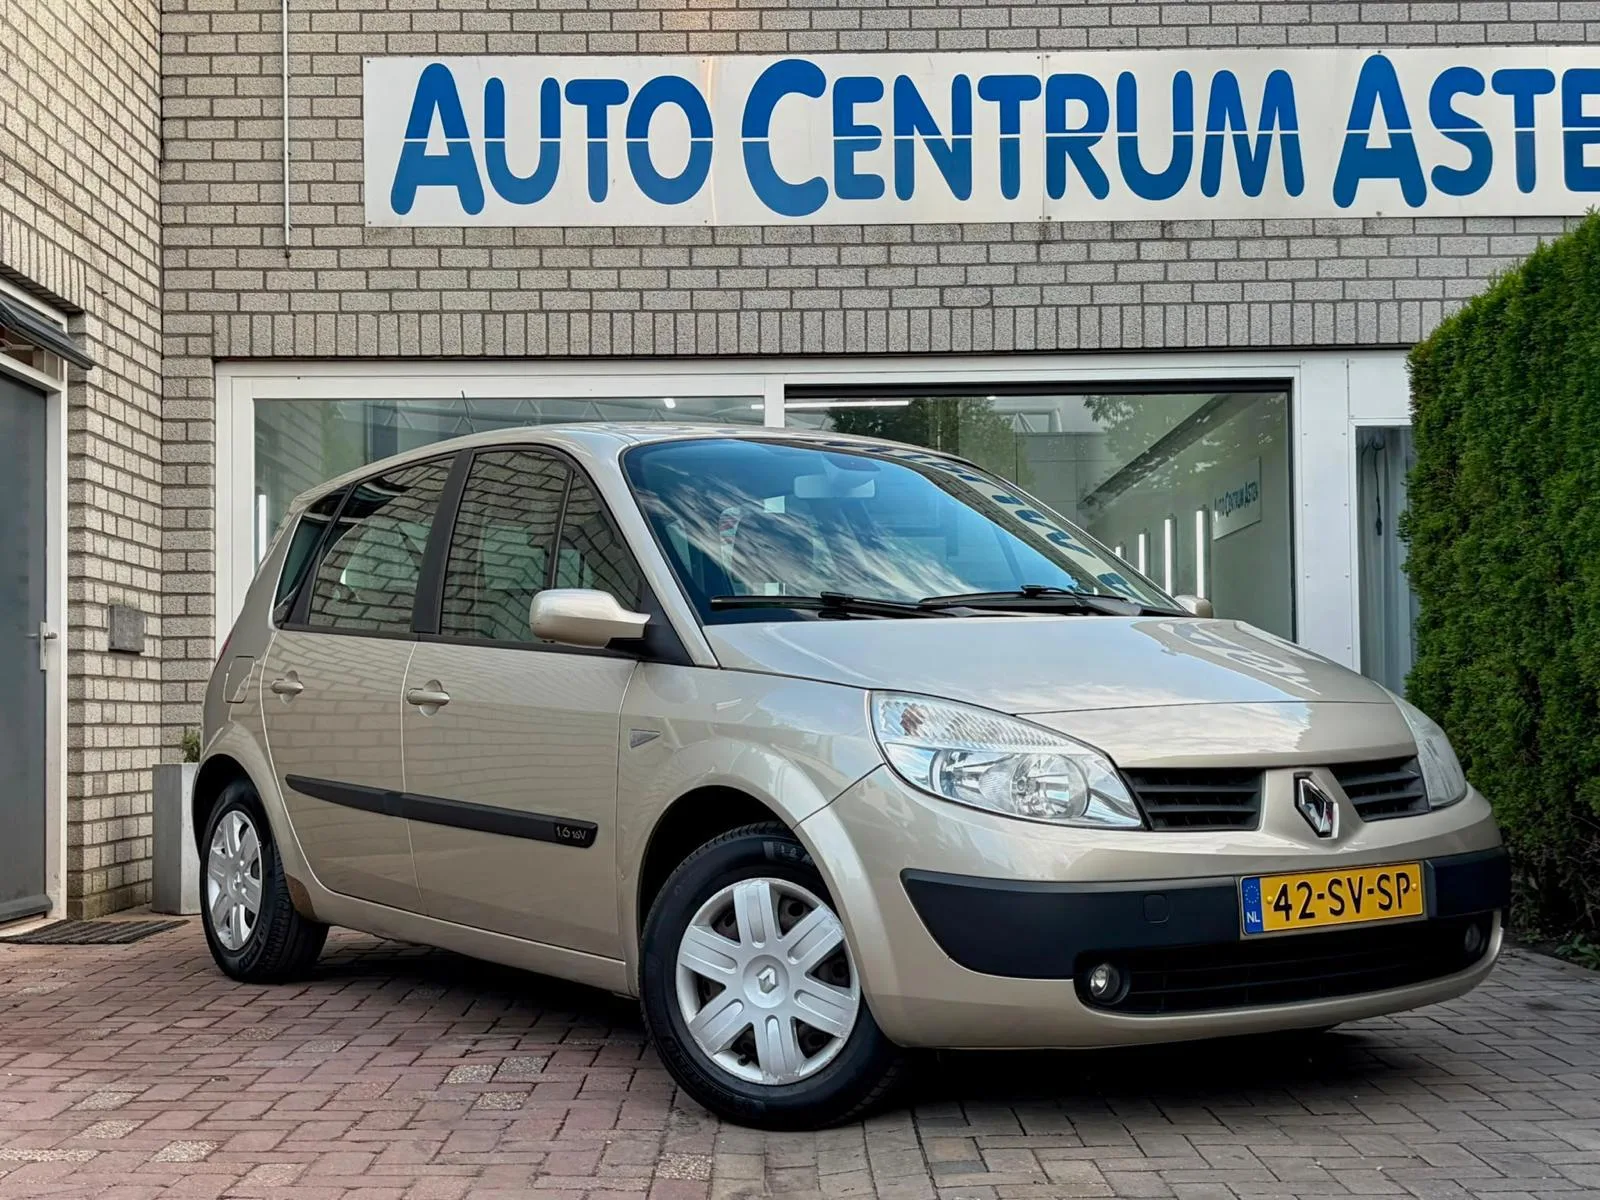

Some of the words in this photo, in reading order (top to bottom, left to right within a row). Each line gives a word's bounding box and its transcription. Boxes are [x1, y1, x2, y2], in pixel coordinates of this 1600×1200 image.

[391, 63, 713, 215] AUTO
[741, 59, 1305, 217] CENTRUM
[1246, 911, 1261, 924] NL
[1273, 872, 1411, 921] 42-SV-SP
